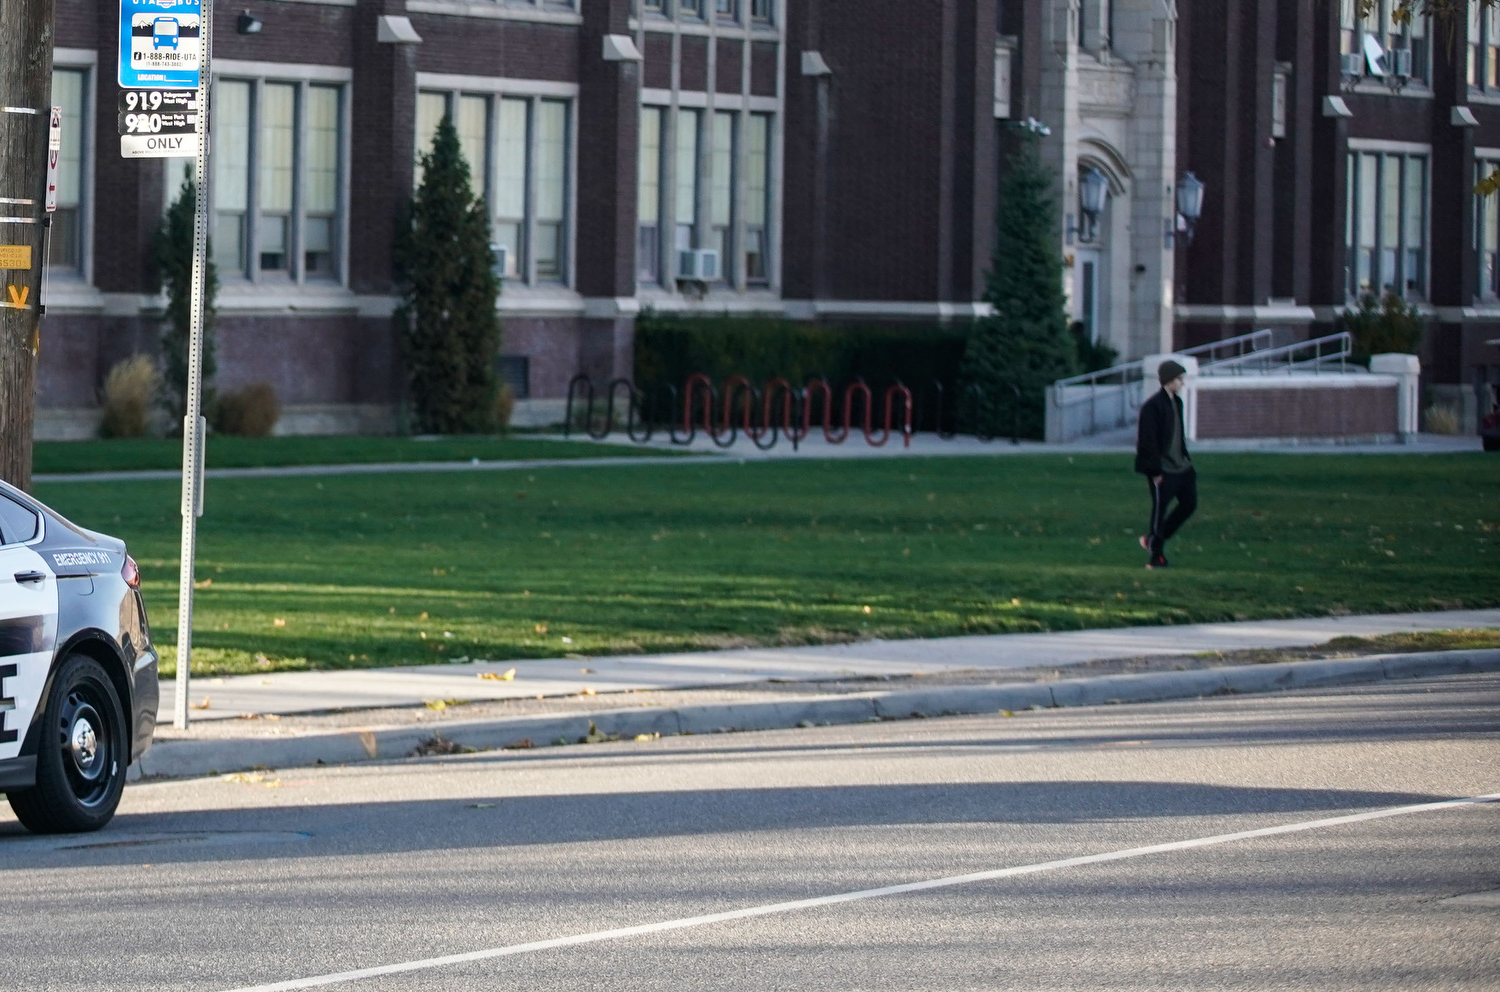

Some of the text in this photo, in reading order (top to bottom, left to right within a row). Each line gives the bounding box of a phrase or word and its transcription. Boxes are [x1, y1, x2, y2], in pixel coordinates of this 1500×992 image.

[142, 53, 197, 61] 1-888-RIDE-UTA
[125, 91, 162, 111] 919
[147, 137, 183, 149] ONLY
[52, 552, 112, 566] EMERGENCY 911
